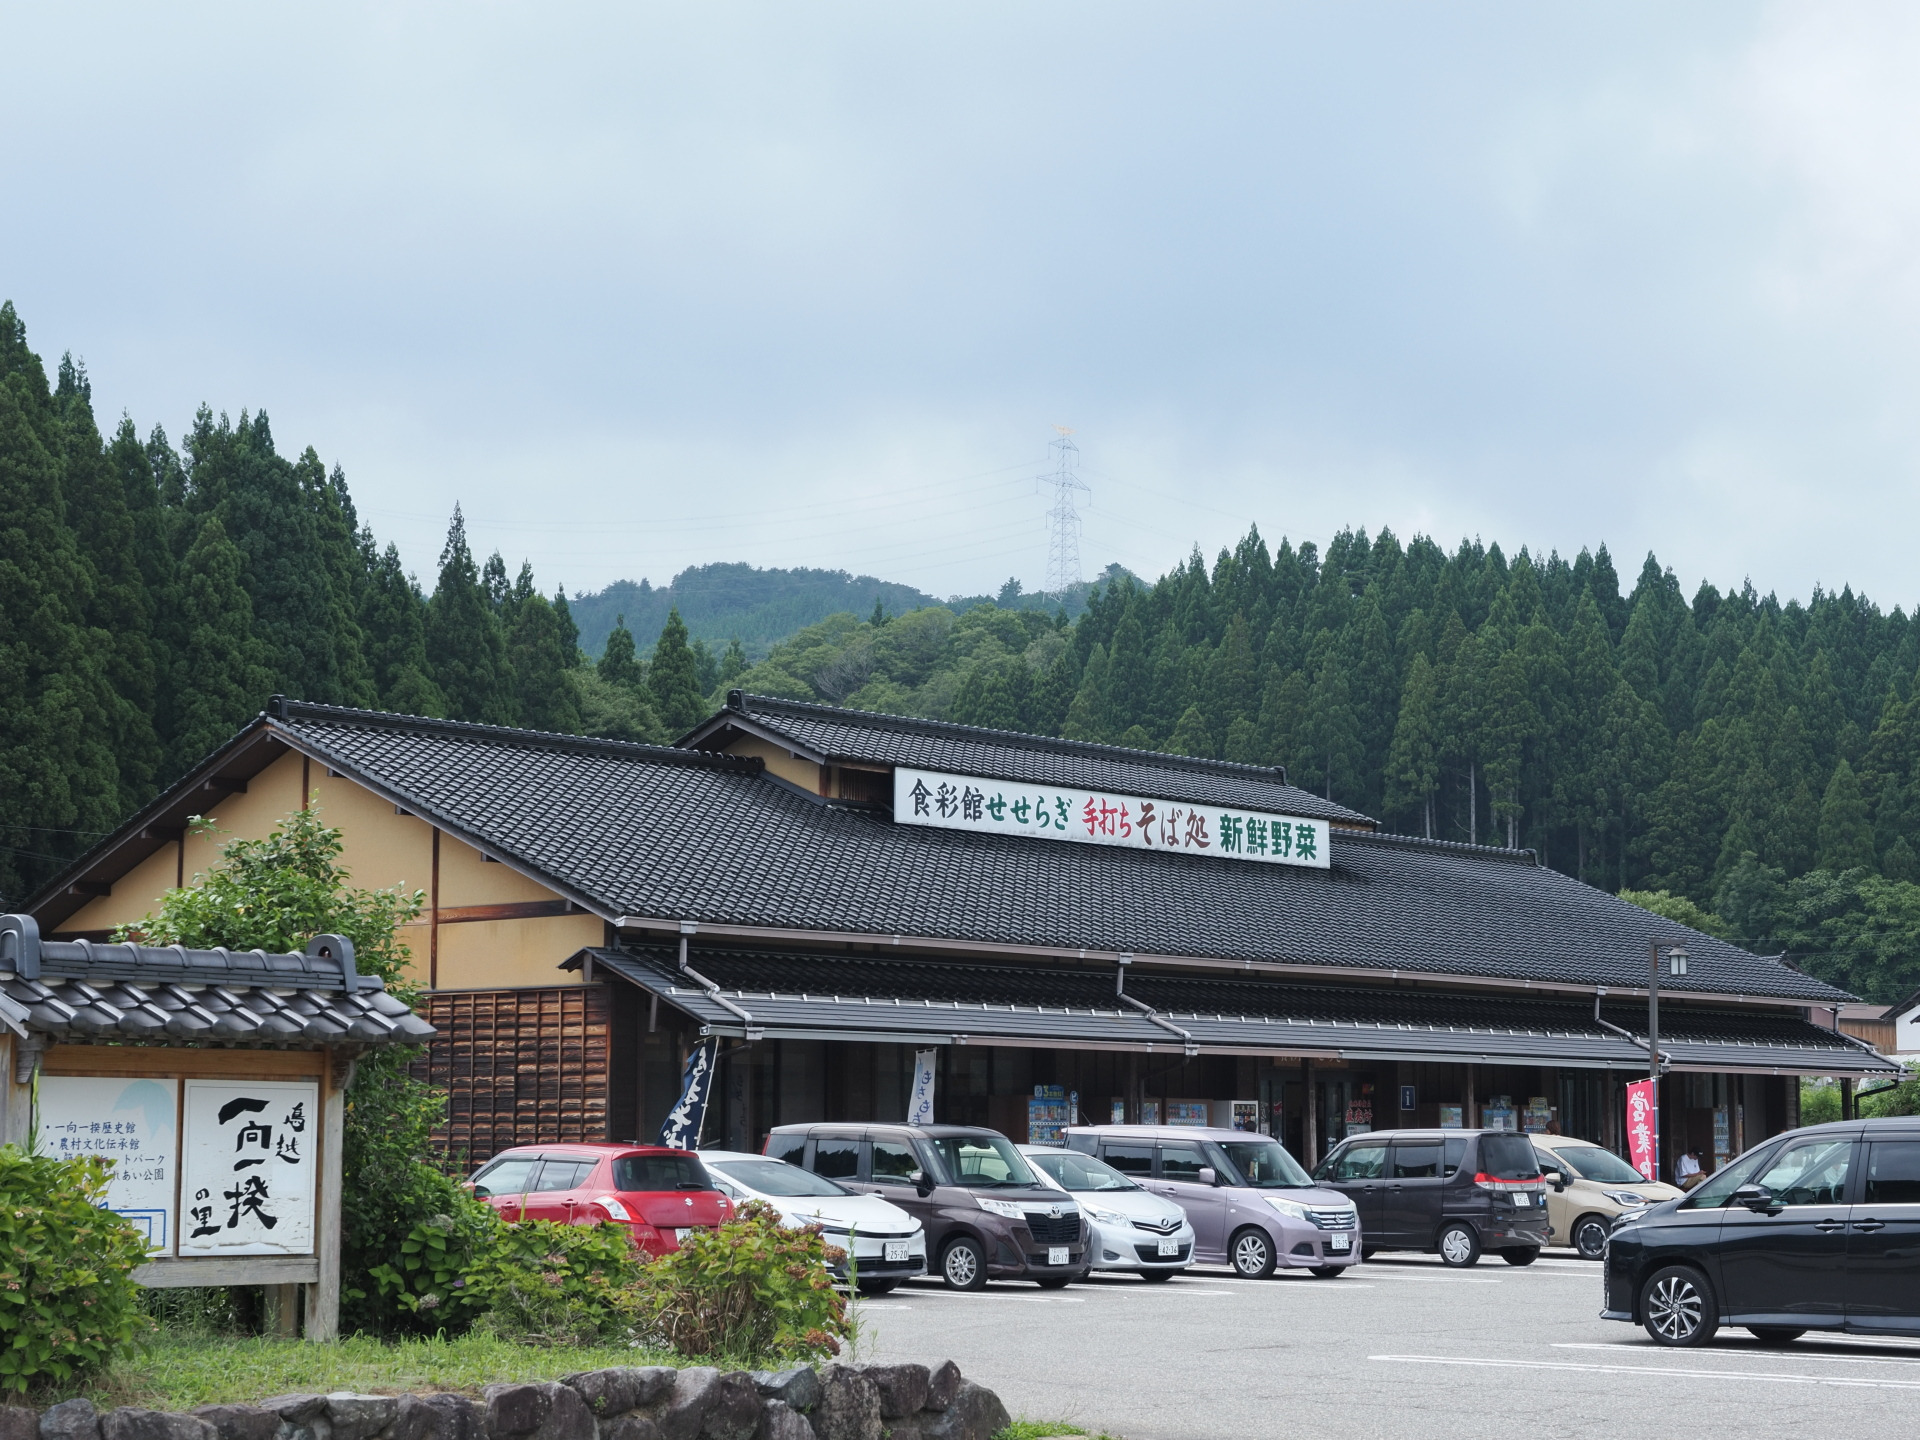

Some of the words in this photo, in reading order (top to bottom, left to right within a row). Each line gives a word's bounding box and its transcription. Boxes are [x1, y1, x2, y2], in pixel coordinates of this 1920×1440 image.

[908, 778, 1072, 831] 食彩館せせらぎ
[1082, 796, 1211, 847] 手打ちそば処
[1219, 814, 1318, 861] 新鮮野菜
[59, 1137, 140, 1150] 農村文化伝承館
[218, 1097, 278, 1230] 一向一揆
[190, 1187, 222, 1238] の里
